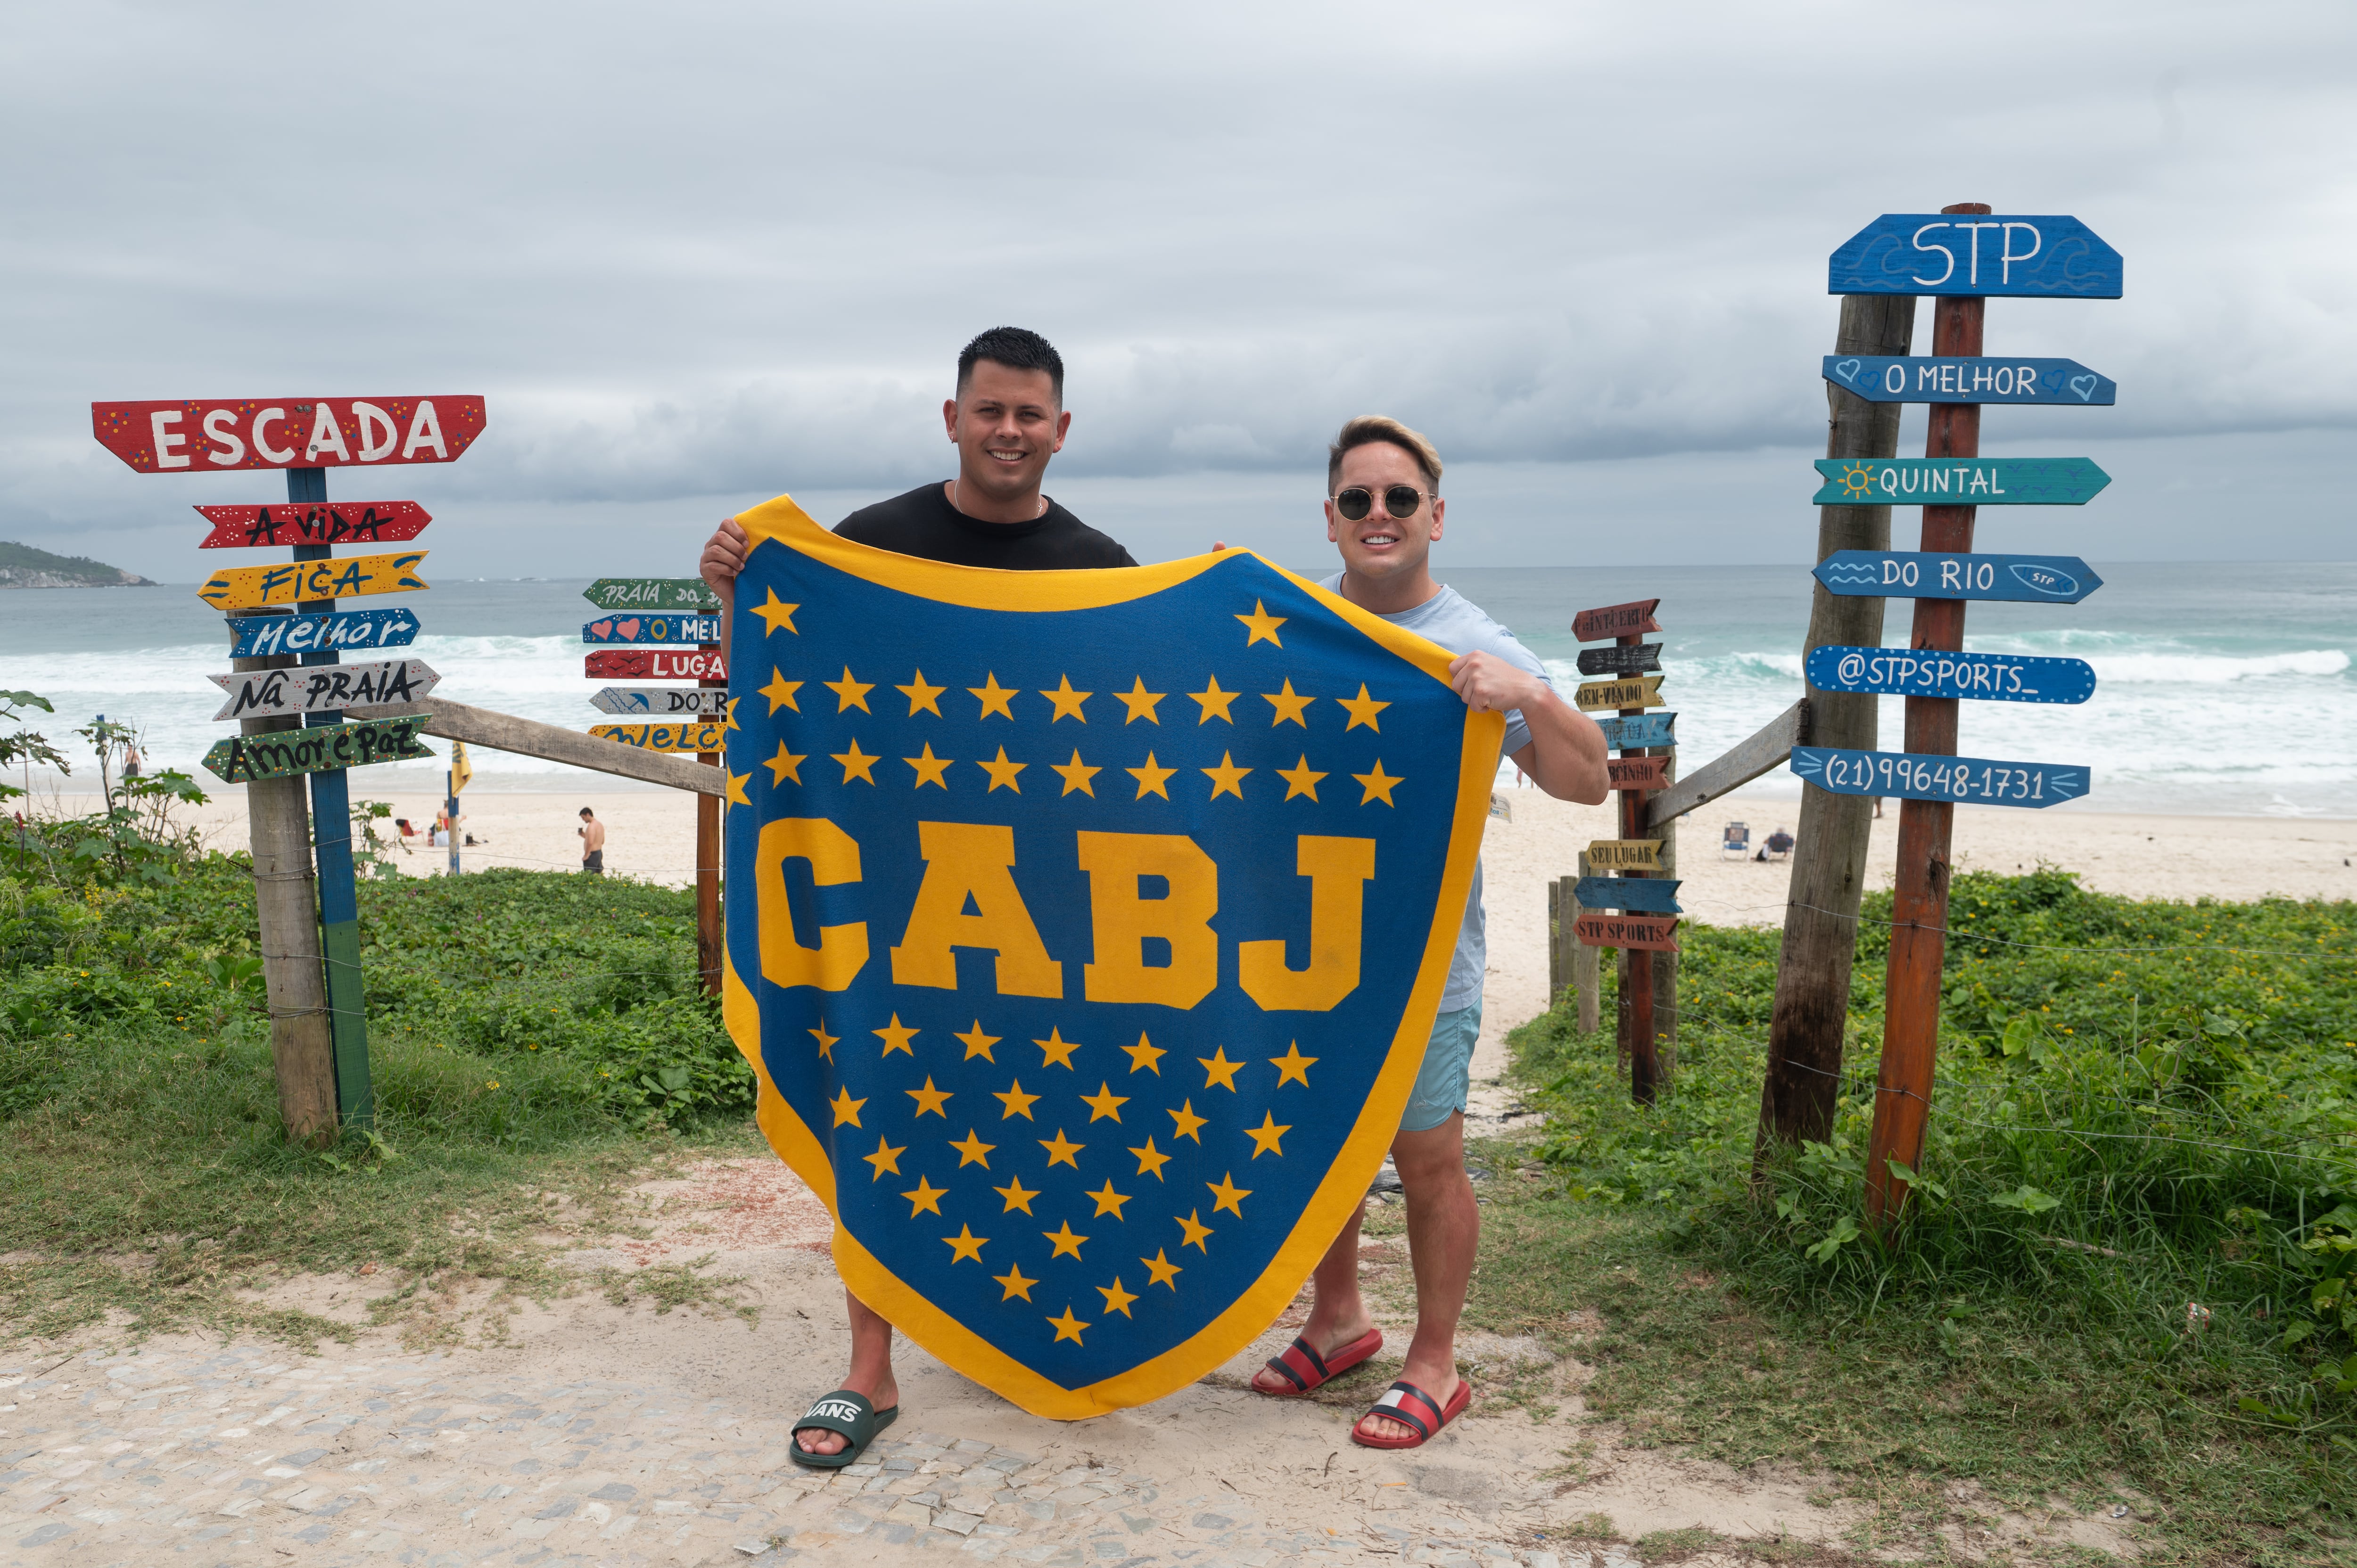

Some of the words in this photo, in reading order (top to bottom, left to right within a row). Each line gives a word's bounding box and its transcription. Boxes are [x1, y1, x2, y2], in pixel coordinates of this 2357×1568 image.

[1912, 222, 2041, 286] STP
[1886, 364, 1906, 394] O
[1918, 365, 2036, 395] MELHOR
[151, 401, 448, 469] ESCADA
[1880, 468, 2005, 497] QUINTAL
[245, 507, 287, 546] A
[1882, 560, 1920, 587] DO
[1940, 561, 1994, 590] RIO
[2032, 573, 2055, 584] STP
[251, 617, 412, 656] Melhor
[653, 653, 726, 678] LUGA
[1838, 653, 2038, 693] @STPSPORTS_
[667, 691, 700, 712] DO
[1591, 847, 1612, 863] SEU
[1615, 846, 1652, 863] LUGAR
[754, 817, 1376, 1012] CABJ
[1578, 921, 1604, 938] STP
[1607, 922, 1665, 942] SPORTS
[803, 1399, 862, 1422] VANS
